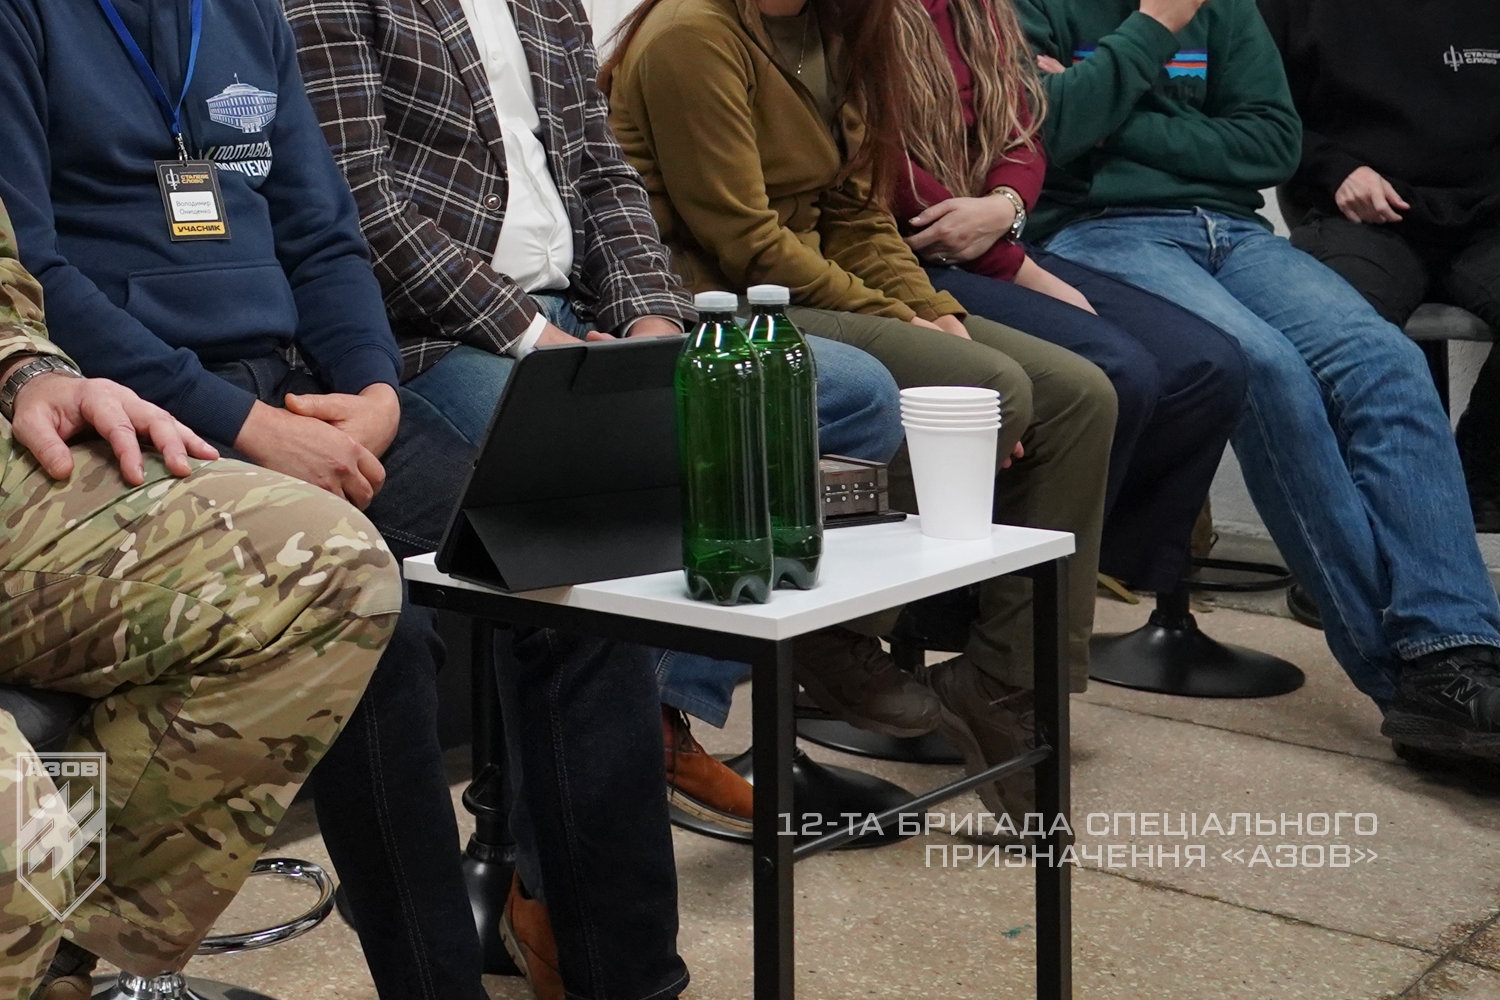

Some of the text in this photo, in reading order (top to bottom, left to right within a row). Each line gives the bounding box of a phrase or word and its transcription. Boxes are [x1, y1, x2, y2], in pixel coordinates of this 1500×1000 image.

[213, 140, 273, 161] ПОЛТАВСЬ
[215, 159, 272, 178] ПОЛІТЕХН
[177, 224, 221, 232] УЧАСНИК
